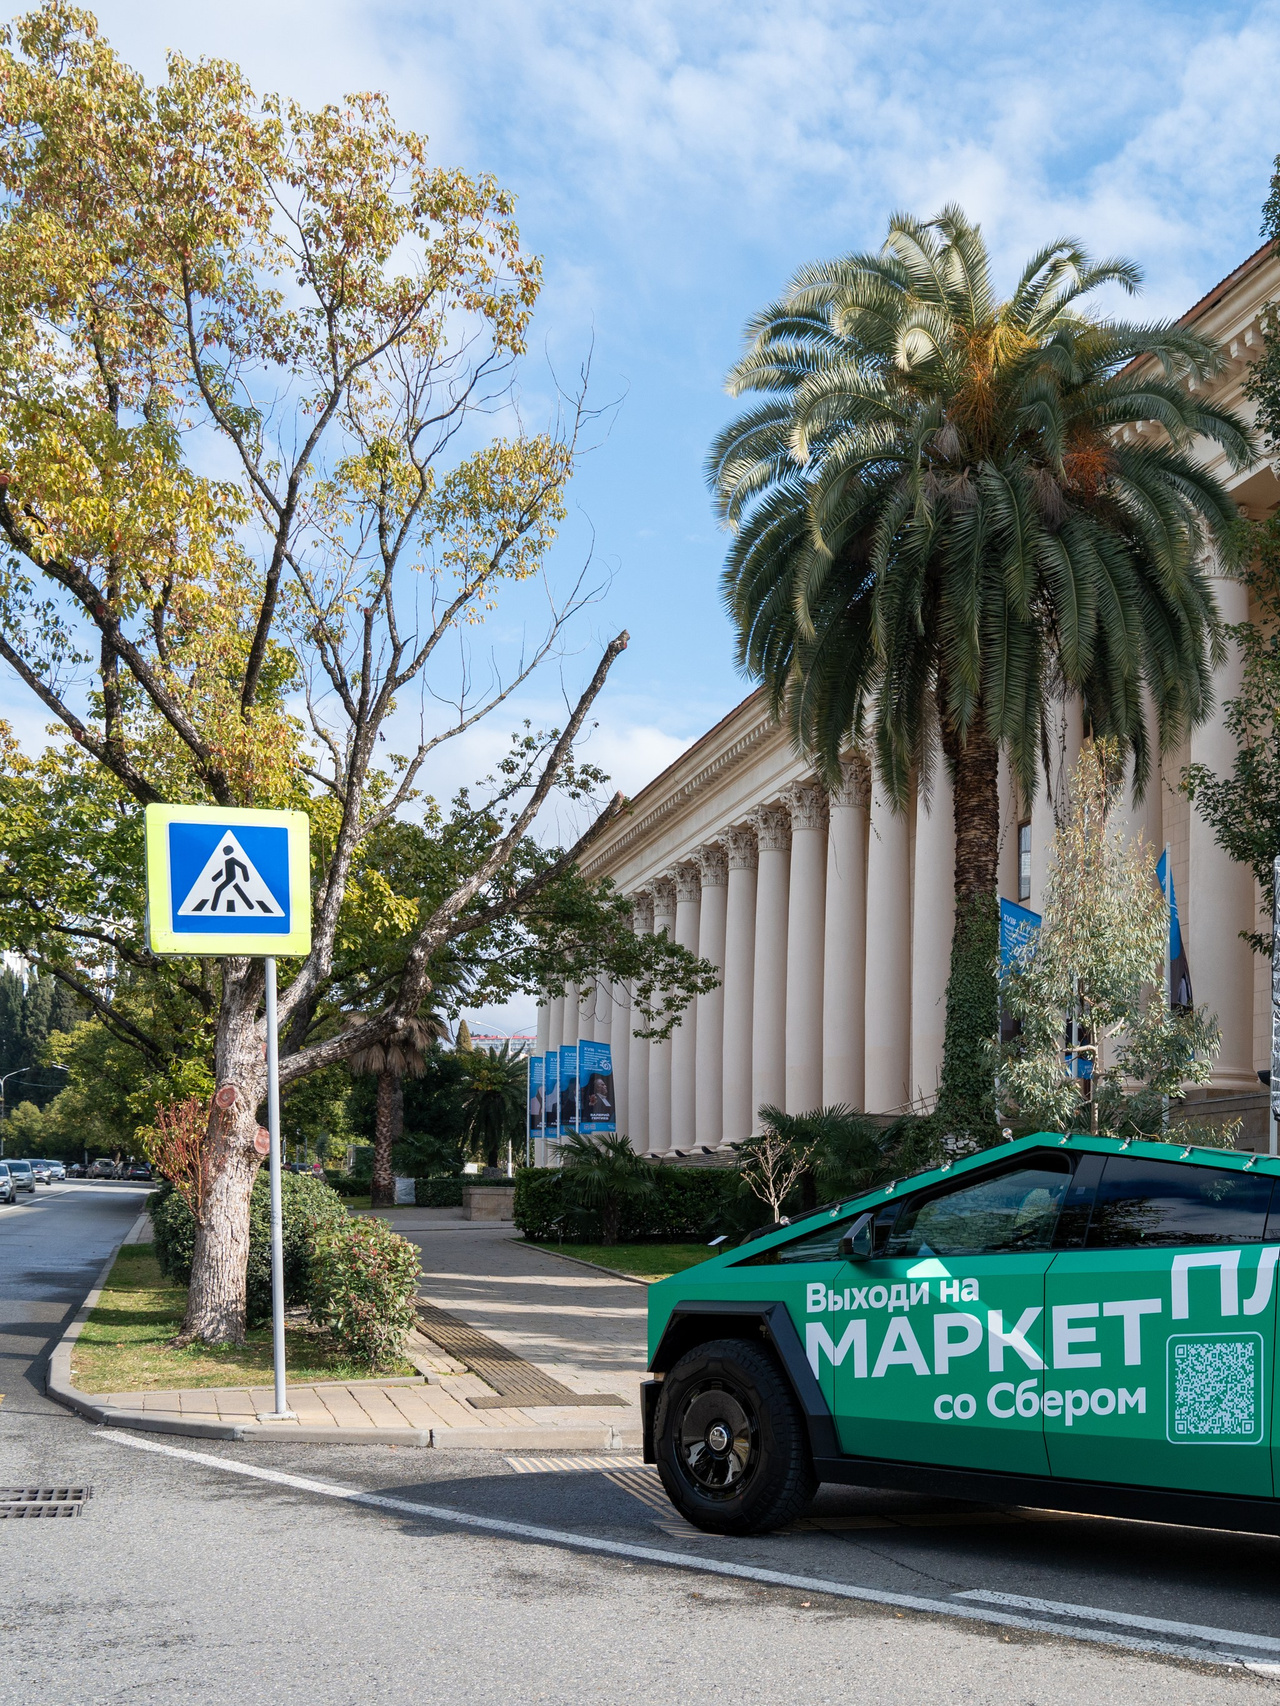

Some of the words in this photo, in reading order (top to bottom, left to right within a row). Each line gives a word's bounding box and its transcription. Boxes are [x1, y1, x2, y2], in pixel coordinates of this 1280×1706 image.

[806, 1282, 930, 1313] Выходи
[939, 1277, 980, 1304] на
[805, 1298, 1162, 1381] МАРКЕТ
[933, 1393, 977, 1420] со
[986, 1378, 1147, 1426] Сбером
